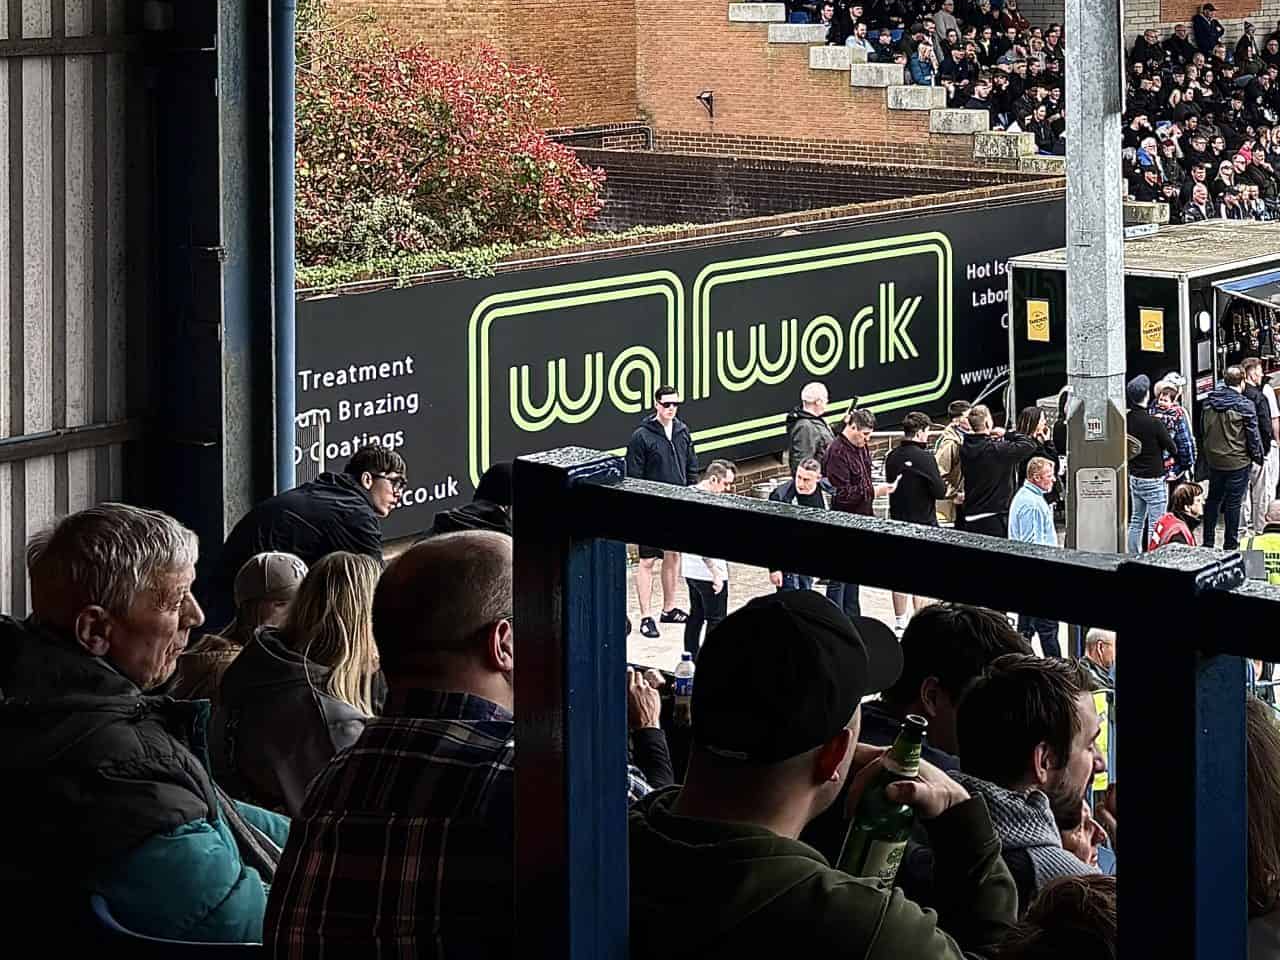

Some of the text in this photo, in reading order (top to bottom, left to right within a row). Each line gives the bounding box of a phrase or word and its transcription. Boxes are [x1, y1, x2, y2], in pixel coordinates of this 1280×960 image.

[966, 263, 990, 280] Hot
[972, 288, 1009, 308] Labor
[299, 355, 415, 391] Treatment
[338, 392, 420, 422] Brazing
[397, 474, 459, 508] .co.uk
